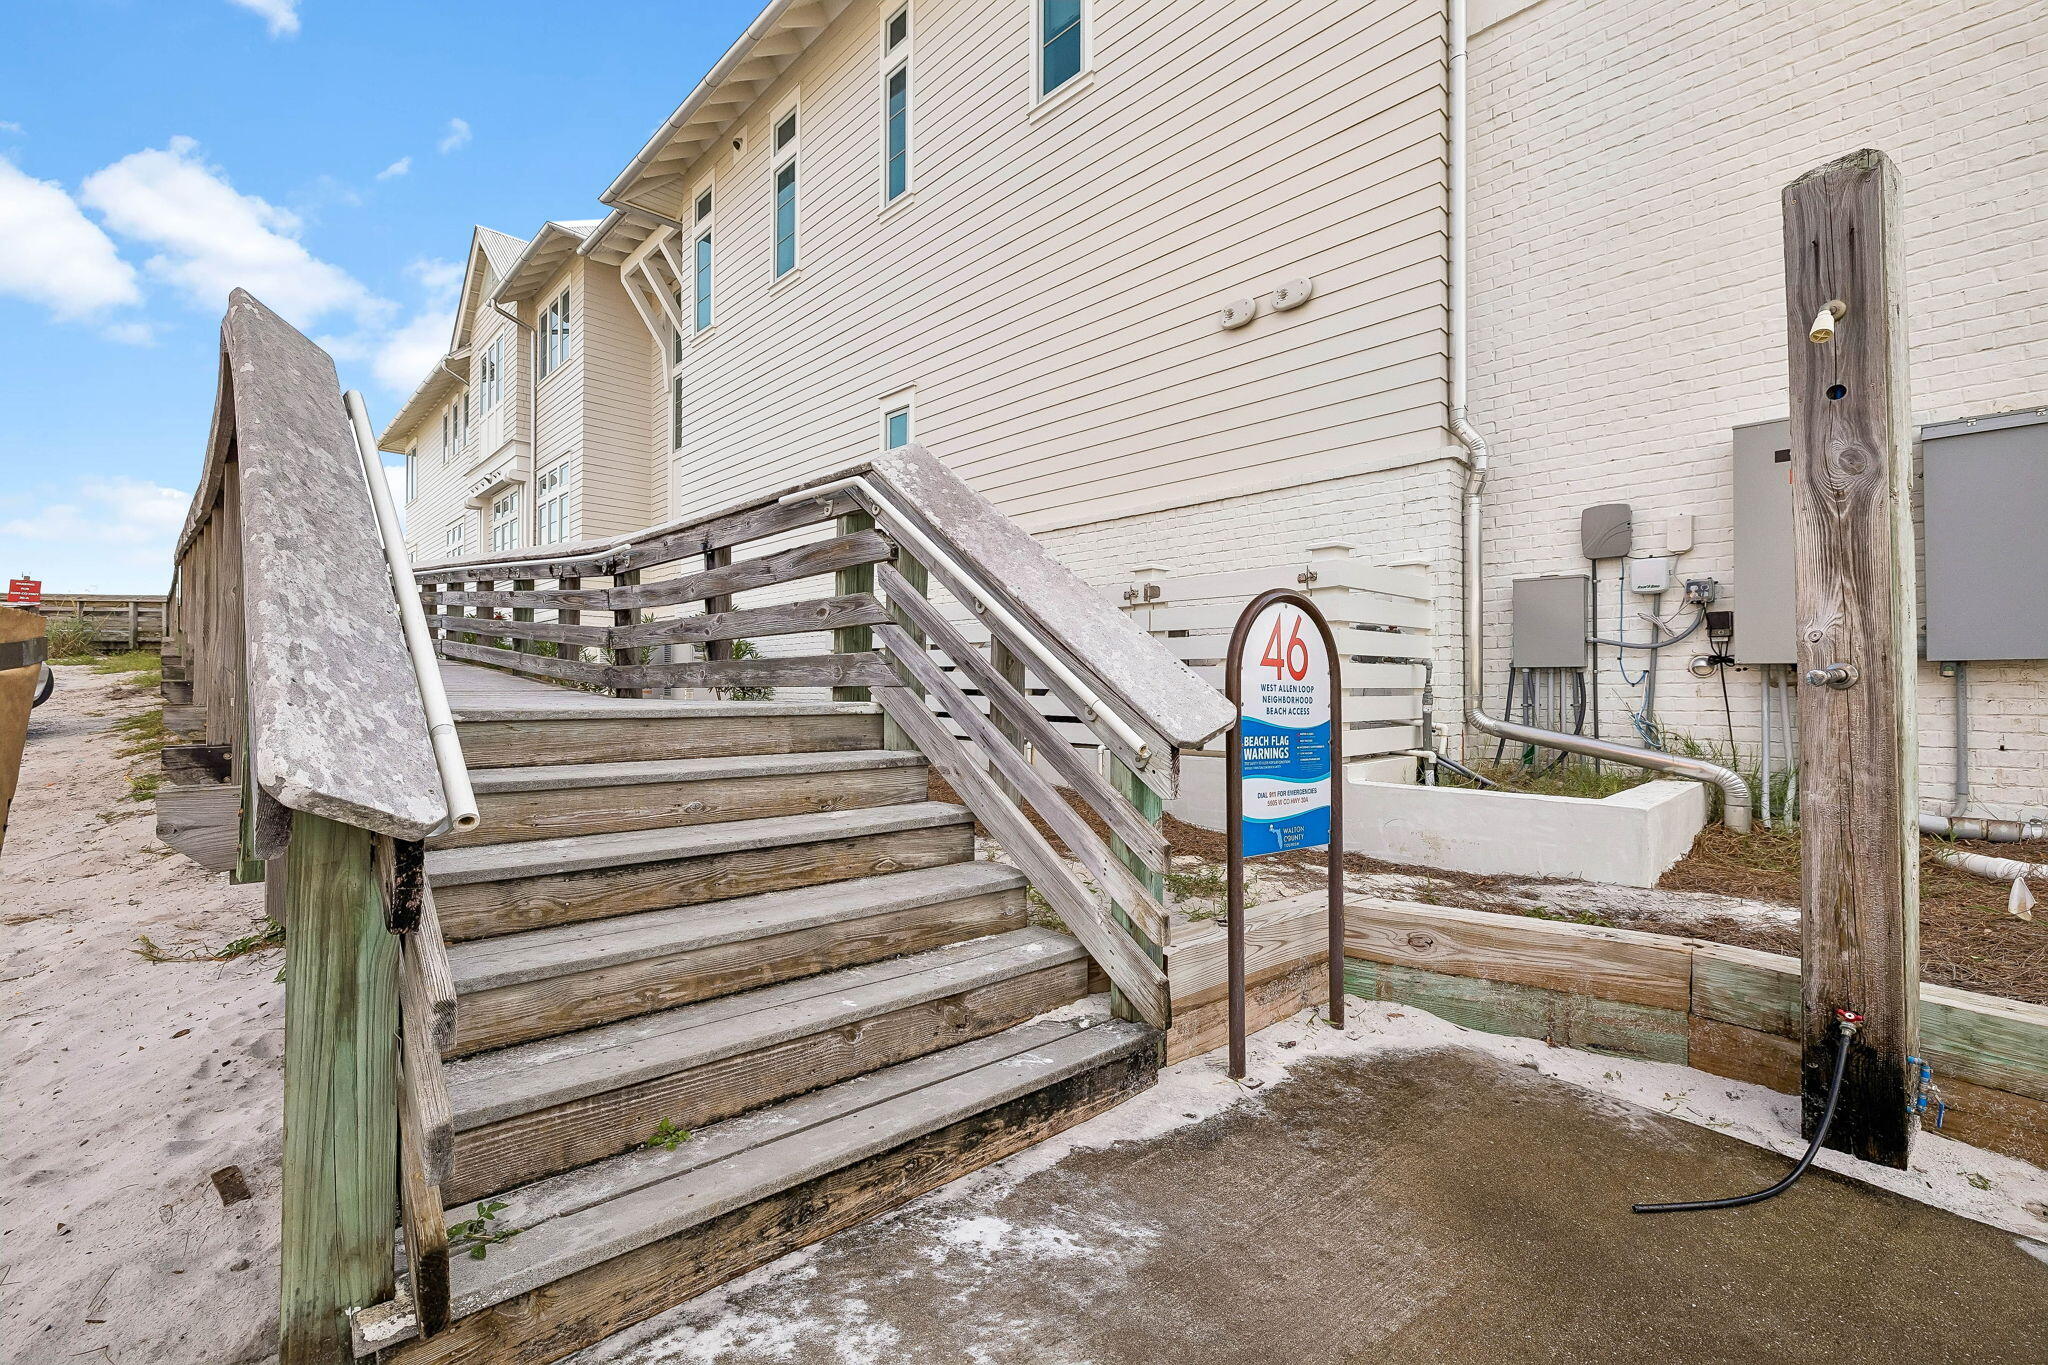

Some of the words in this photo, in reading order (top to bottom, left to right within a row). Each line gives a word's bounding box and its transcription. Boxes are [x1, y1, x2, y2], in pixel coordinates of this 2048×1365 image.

[1259, 612, 1309, 681] 46
[1260, 684, 1277, 692] WEST
[1278, 684, 1297, 693] ALLEN
[1298, 685, 1315, 693] LOOP
[1262, 696, 1313, 704] NEIGHBORHOOD
[1266, 707, 1287, 715] BEACH
[1288, 708, 1310, 716] ACCESS
[1243, 736, 1269, 747] BEACH
[1271, 735, 1289, 746] FLAG
[1243, 747, 1289, 760] WARNINGS
[1287, 787, 1318, 796] EMERGENCIES
[1283, 826, 1305, 834] WALTON
[1283, 834, 1304, 842] COUNTY
